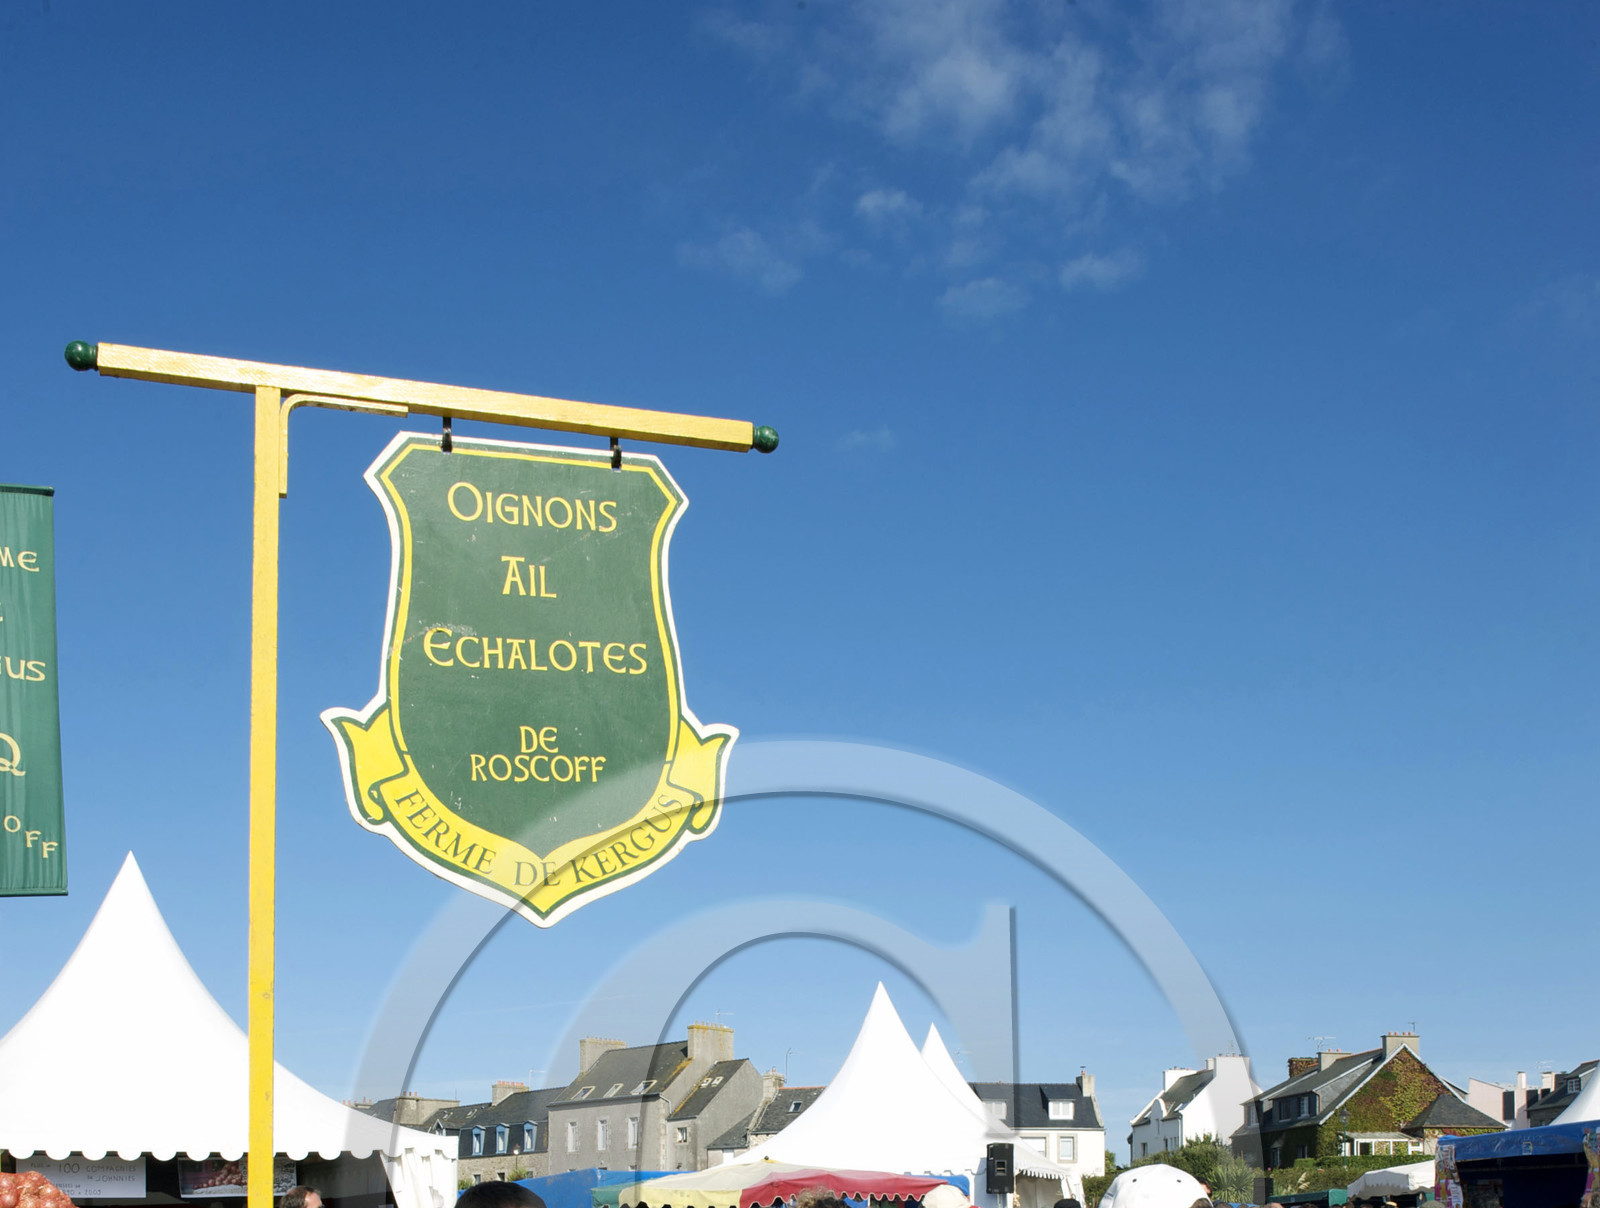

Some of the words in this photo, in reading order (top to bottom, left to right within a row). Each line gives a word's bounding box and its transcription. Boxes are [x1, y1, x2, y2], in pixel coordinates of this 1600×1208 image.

[446, 481, 617, 532] OIGNONS
[501, 555, 557, 598] AIL
[0, 655, 46, 682] US
[422, 627, 647, 675] ECHALOTES
[519, 725, 558, 753] DE
[470, 754, 606, 783] ROSCOFF
[395, 788, 497, 875] FERME
[513, 861, 560, 887] DE
[571, 794, 683, 884] KERGUS
[59, 1162, 80, 1174] 100
